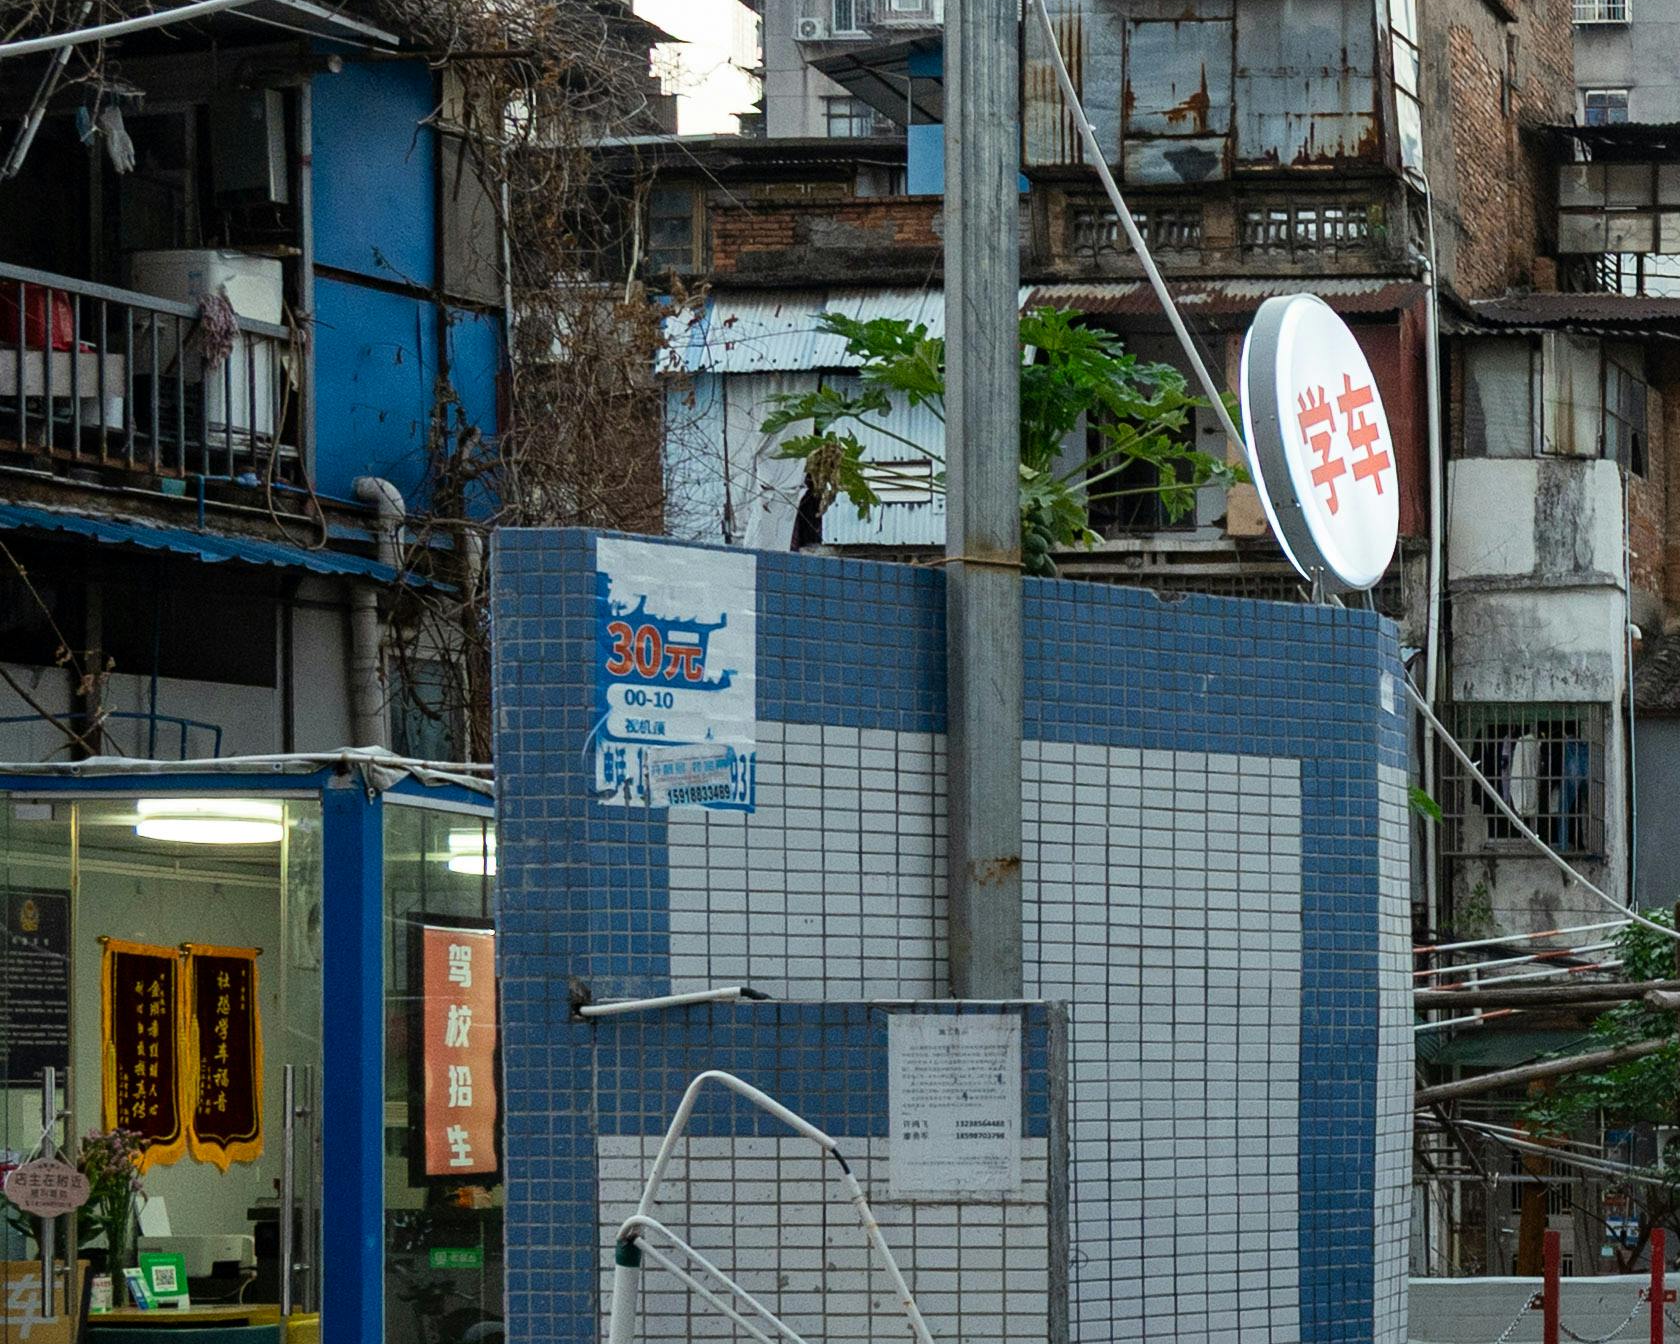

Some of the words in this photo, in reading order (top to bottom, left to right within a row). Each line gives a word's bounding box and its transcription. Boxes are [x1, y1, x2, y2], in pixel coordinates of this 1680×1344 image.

[1297, 373, 1391, 516] 学车
[605, 621, 704, 681] 30元
[444, 943, 473, 1168] 驾校招生
[15, 1172, 82, 1188] 店主在附近
